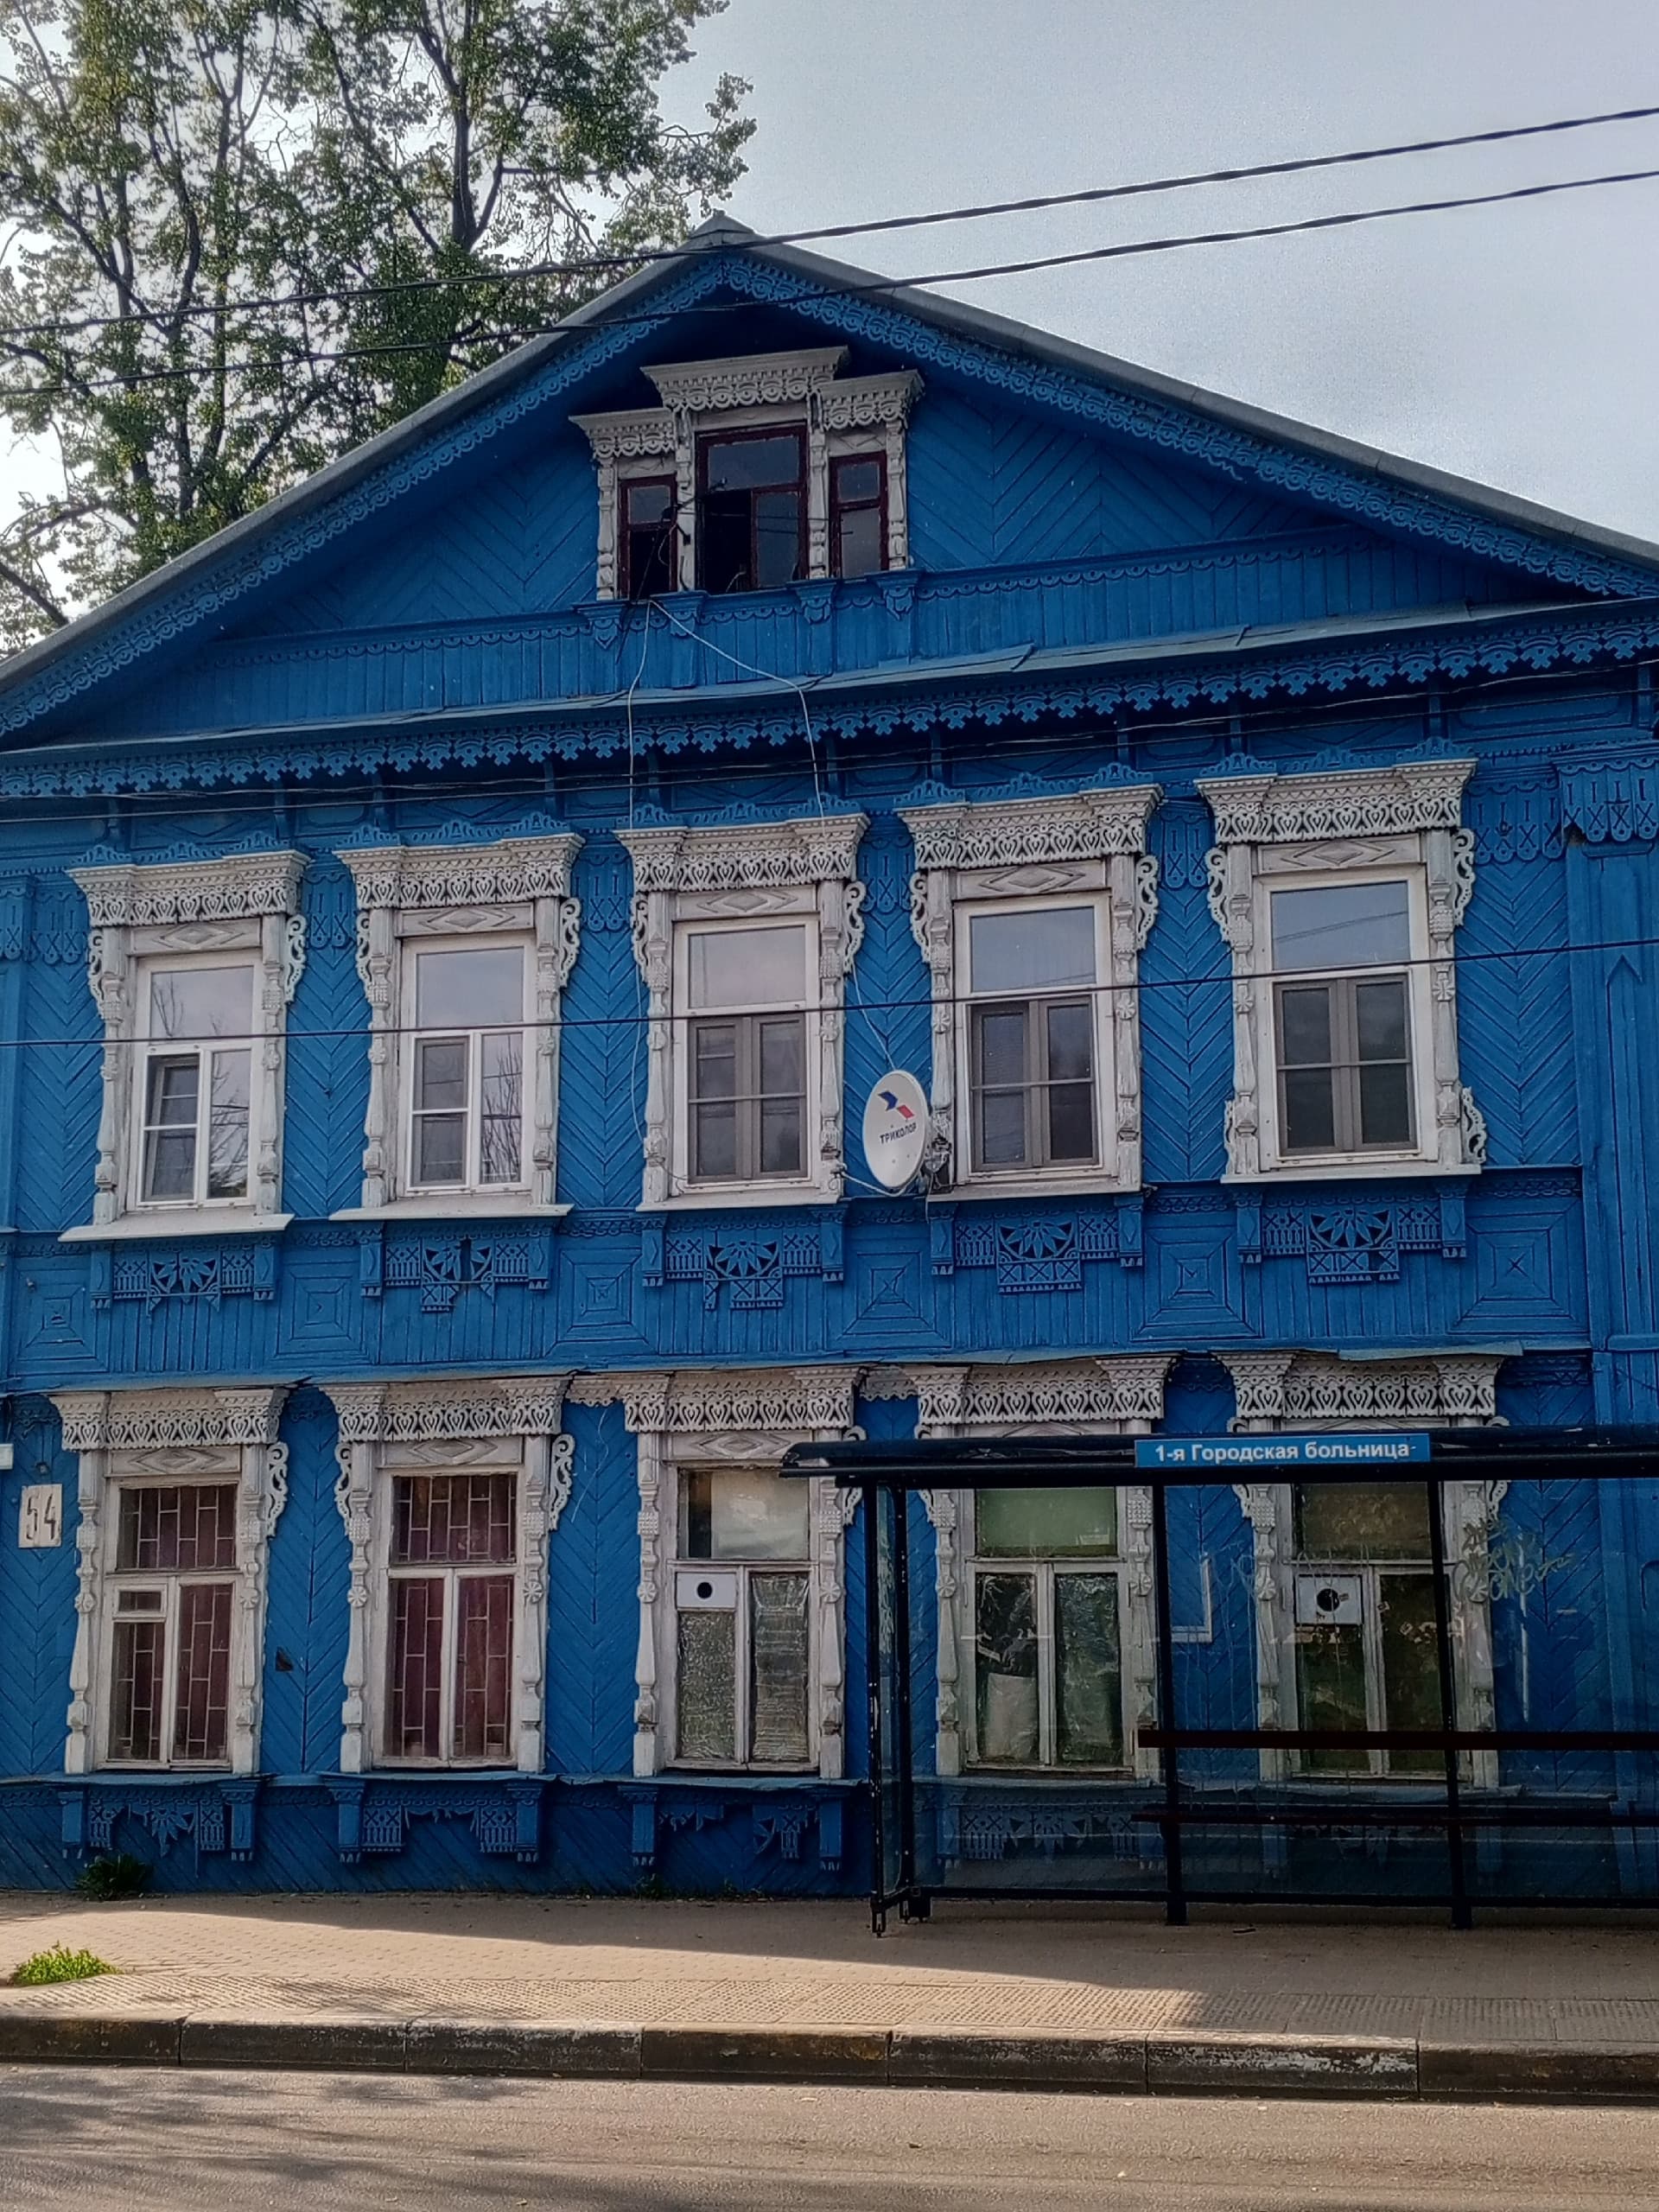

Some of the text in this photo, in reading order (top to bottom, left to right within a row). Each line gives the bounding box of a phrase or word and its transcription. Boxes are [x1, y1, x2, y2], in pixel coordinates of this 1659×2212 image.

[880, 1122, 917, 1144] ТРИКОЛОР
[1155, 1441, 1410, 1464] 1-я Городская больница
[27, 1492, 56, 1540] 54
